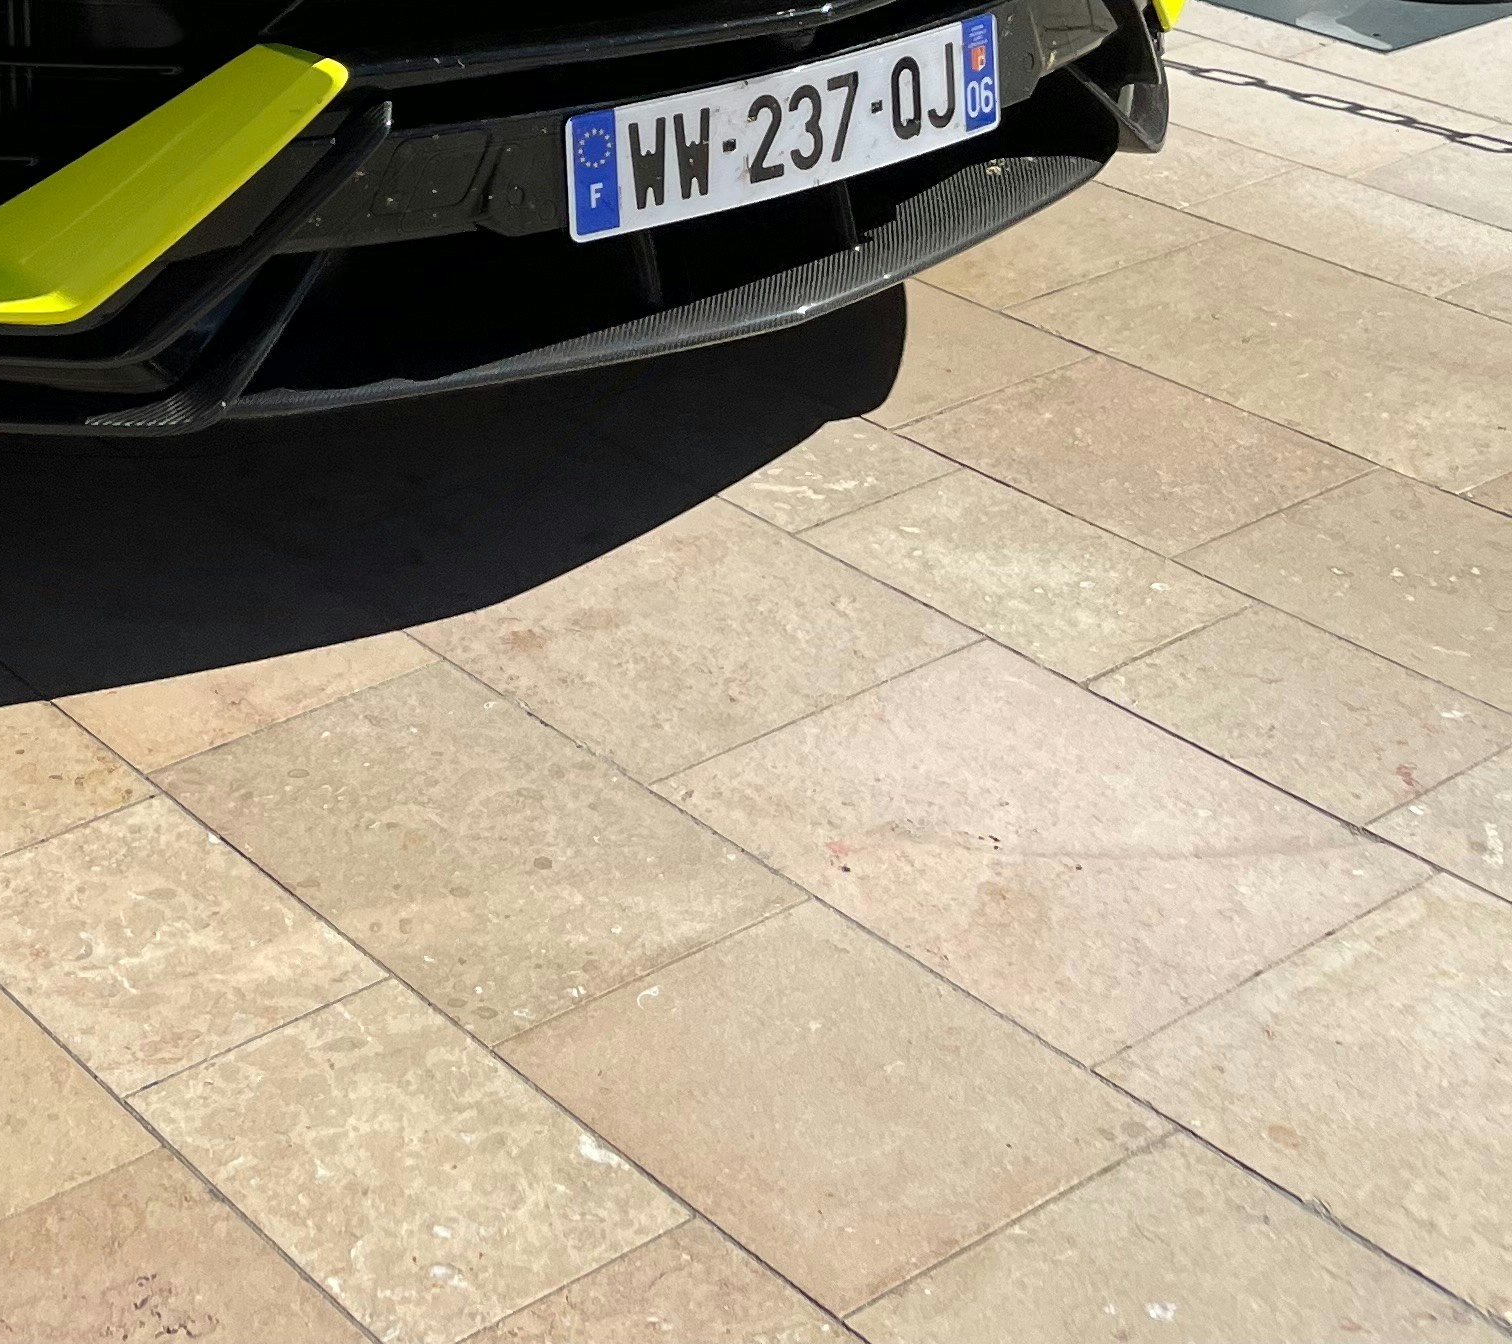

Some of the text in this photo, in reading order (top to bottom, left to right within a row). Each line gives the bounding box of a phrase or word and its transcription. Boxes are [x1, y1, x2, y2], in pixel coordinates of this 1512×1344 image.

[966, 76, 994, 118] 06
[628, 42, 955, 210] WW-237-QJ
[590, 182, 604, 209] F
